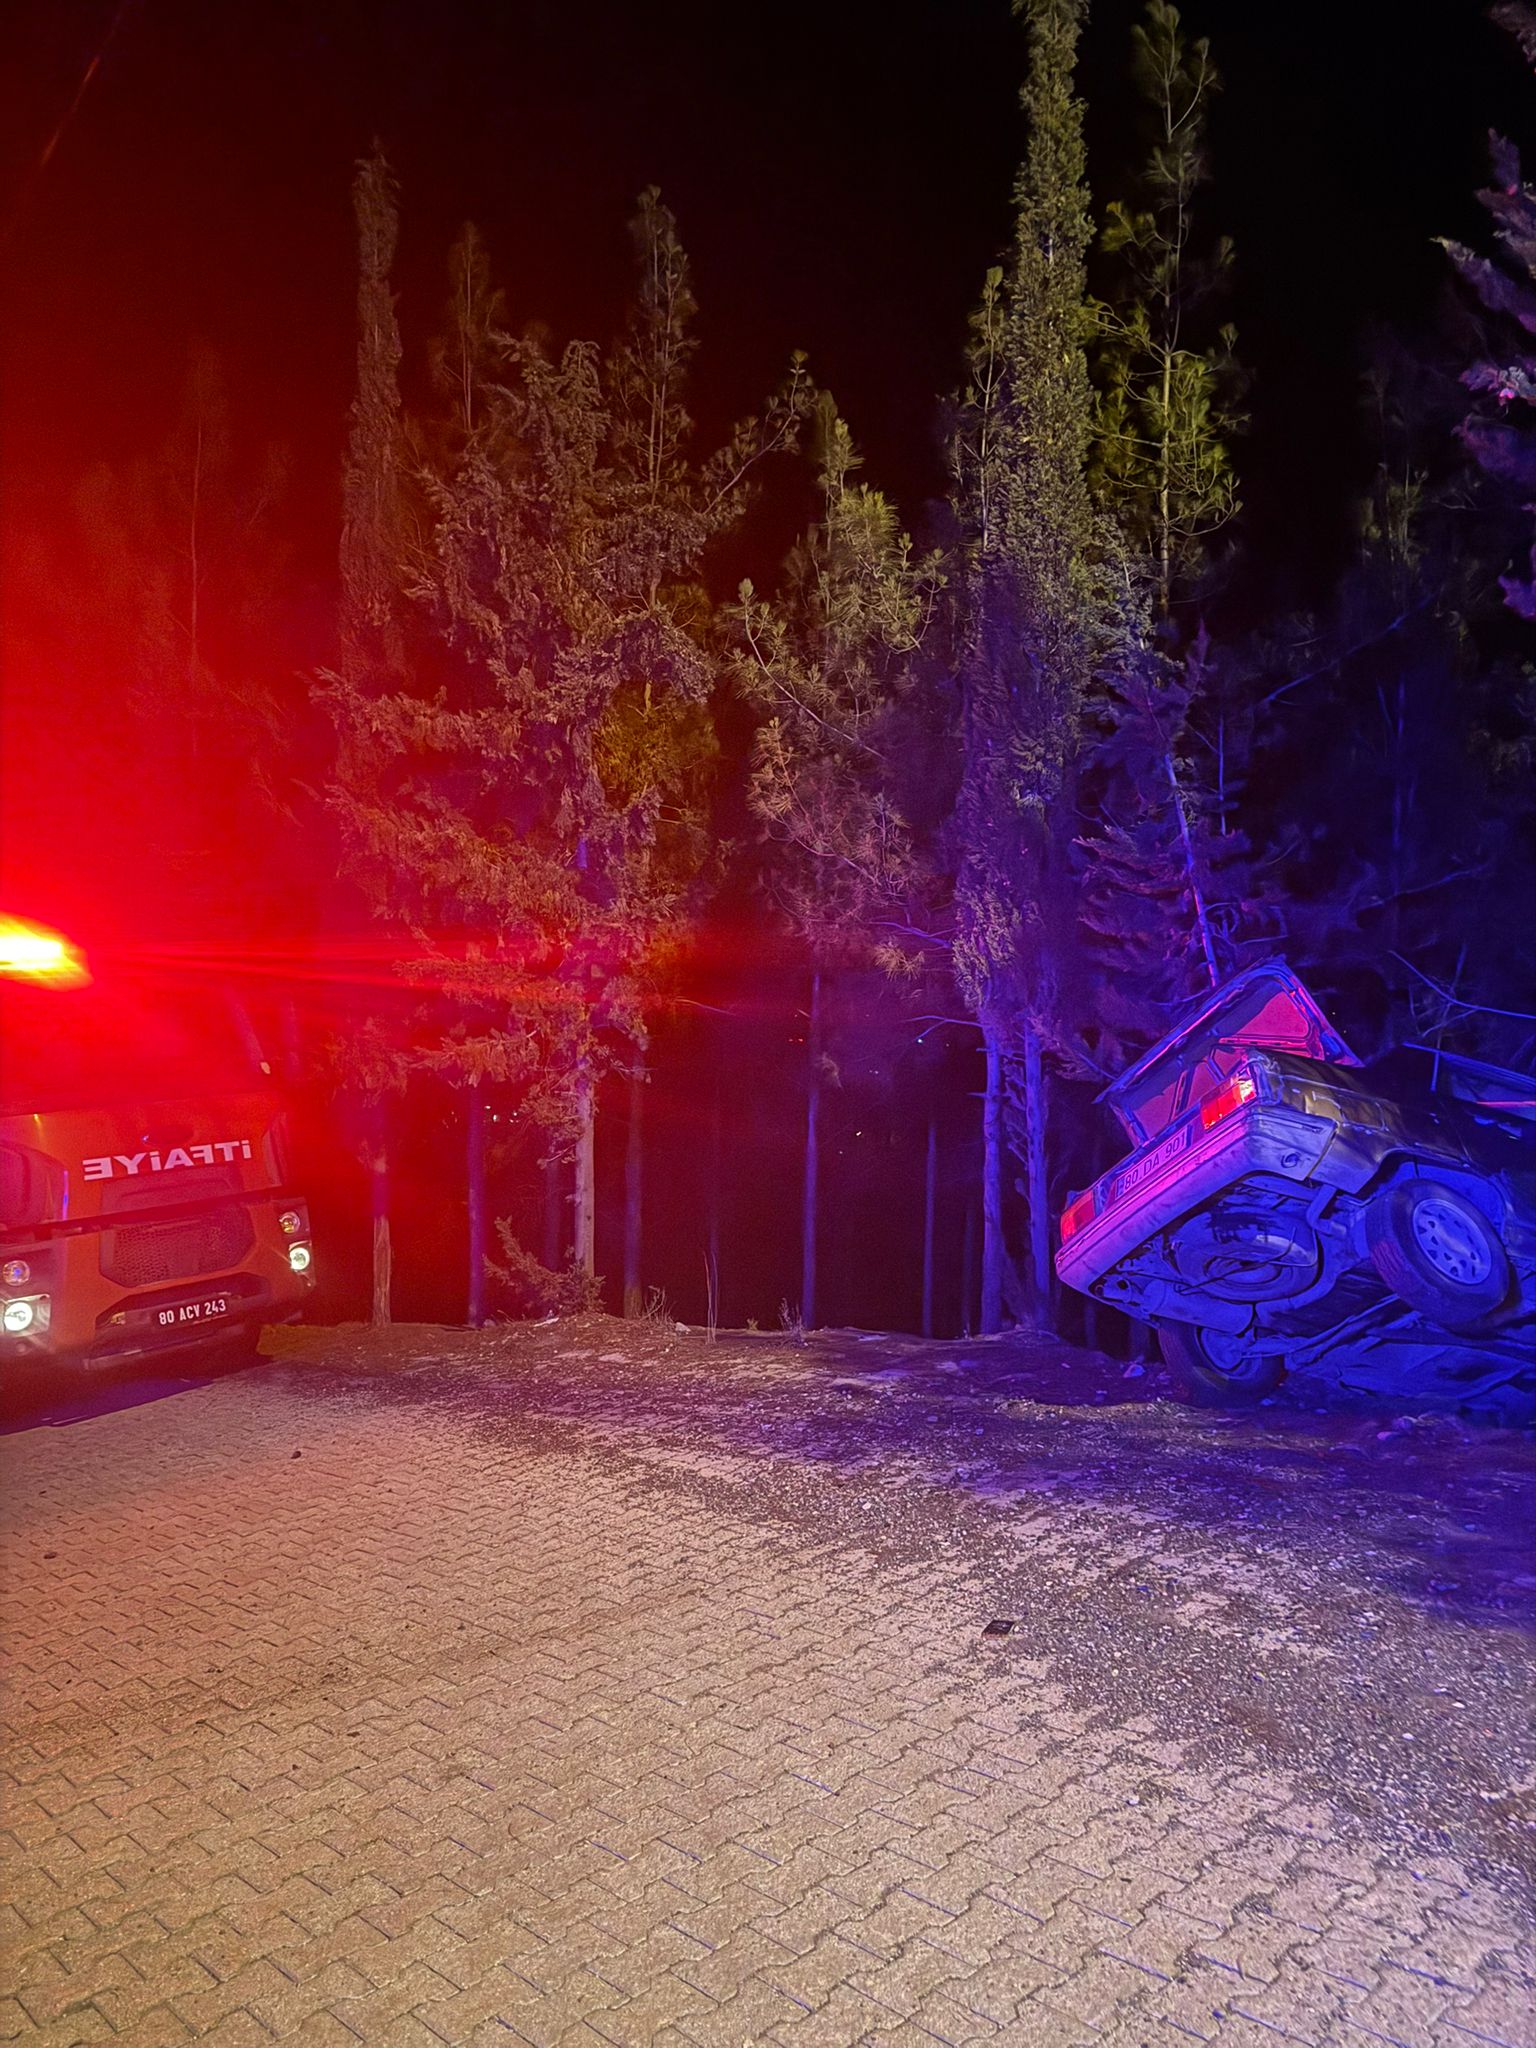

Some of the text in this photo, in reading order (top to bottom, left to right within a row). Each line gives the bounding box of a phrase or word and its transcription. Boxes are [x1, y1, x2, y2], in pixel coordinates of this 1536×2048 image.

[1125, 1131, 1186, 1190] 80 DA 901
[159, 1299, 226, 1325] 80 ACV 243
